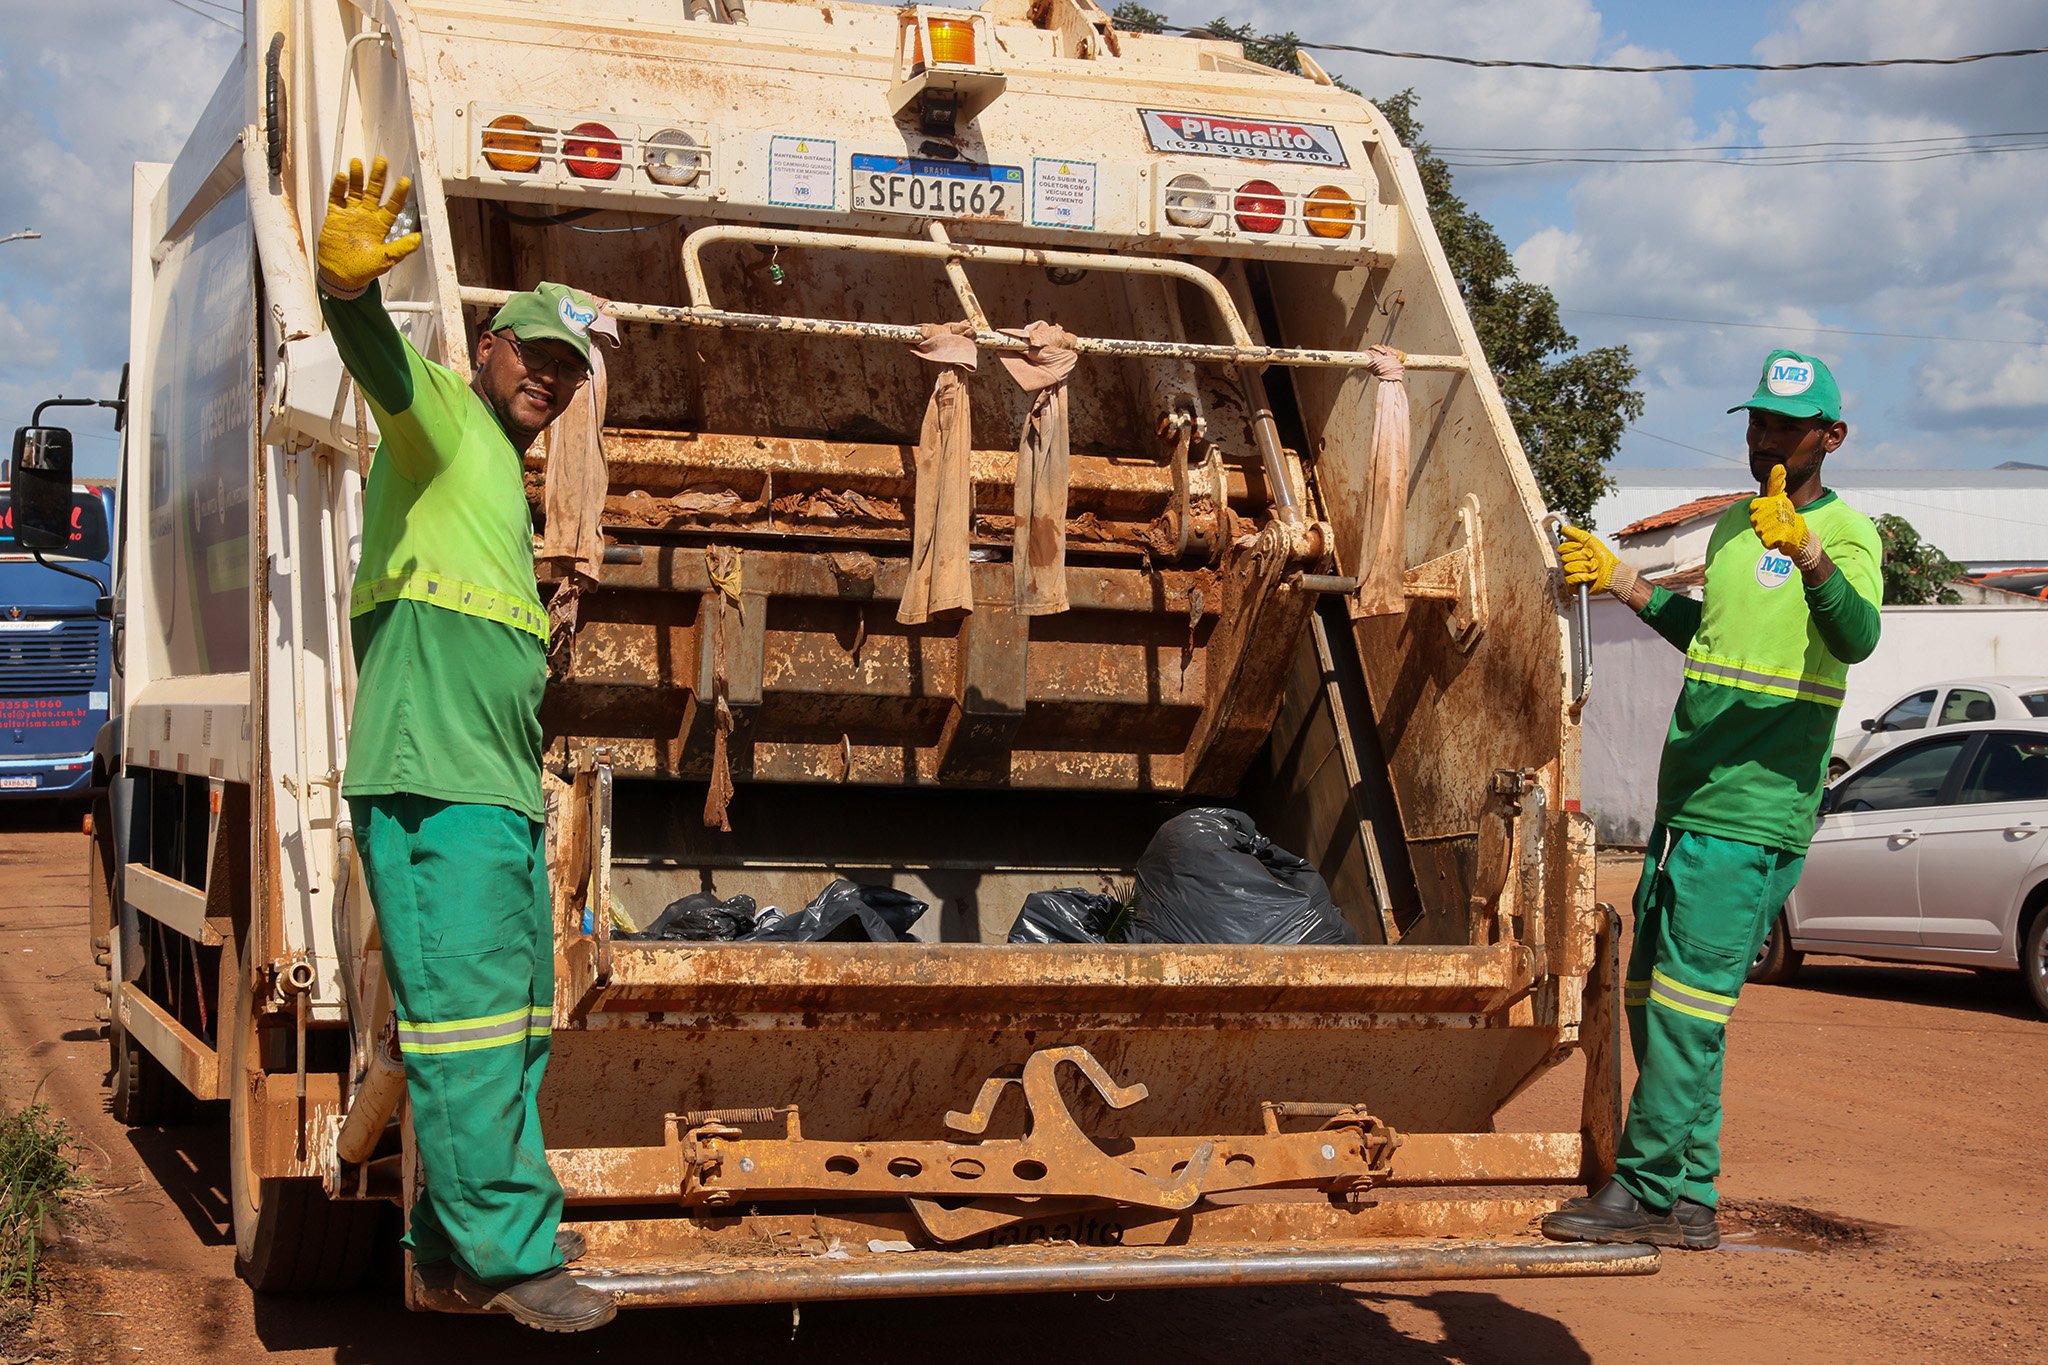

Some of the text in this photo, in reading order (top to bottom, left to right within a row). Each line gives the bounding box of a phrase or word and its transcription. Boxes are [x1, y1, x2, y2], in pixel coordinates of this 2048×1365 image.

[1166, 140, 1333, 162] (62) 3237-2400
[923, 165, 951, 175] BRASIL
[1039, 181, 1068, 189] COLETOR
[856, 196, 865, 206] BR
[1045, 196, 1083, 204] MOVIMENTO
[1772, 366, 1808, 382] MB
[1760, 556, 1792, 575] MB
[0, 700, 62, 710] 3358-1060
[986, 1214, 1124, 1249] lanalto
